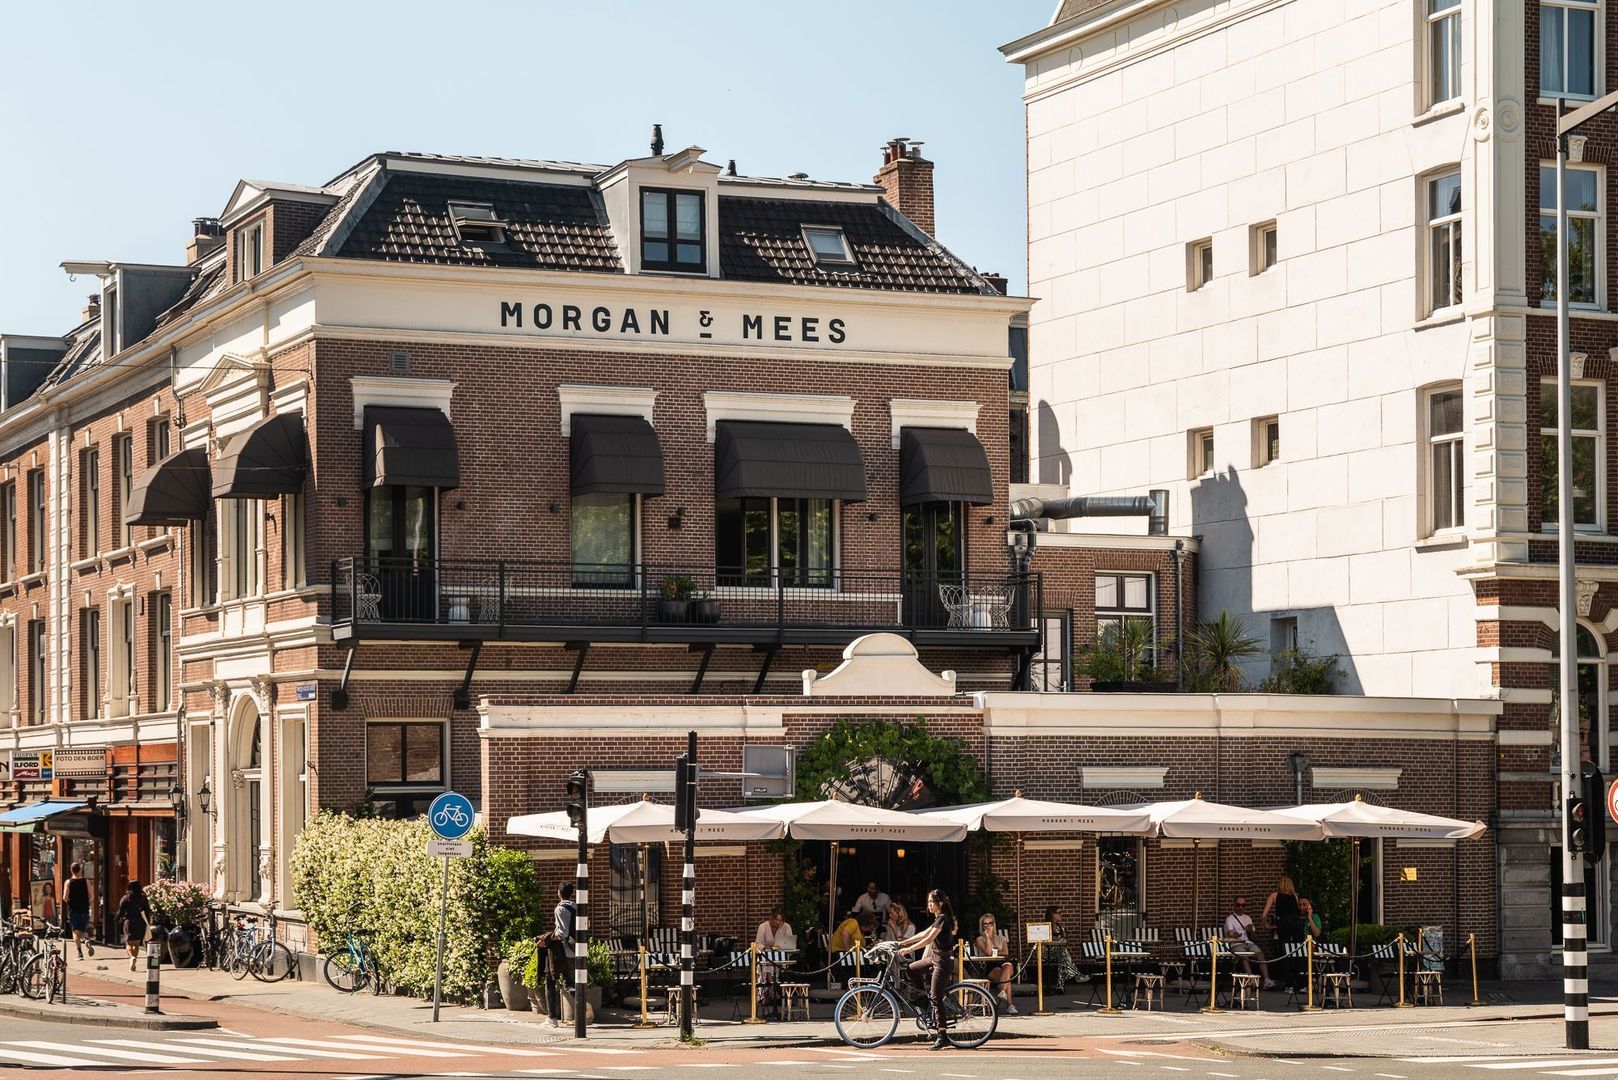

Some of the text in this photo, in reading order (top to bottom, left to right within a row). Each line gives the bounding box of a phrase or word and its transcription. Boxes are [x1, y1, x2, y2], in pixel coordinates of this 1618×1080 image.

[501, 302, 846, 344] MORGAN & MEES
